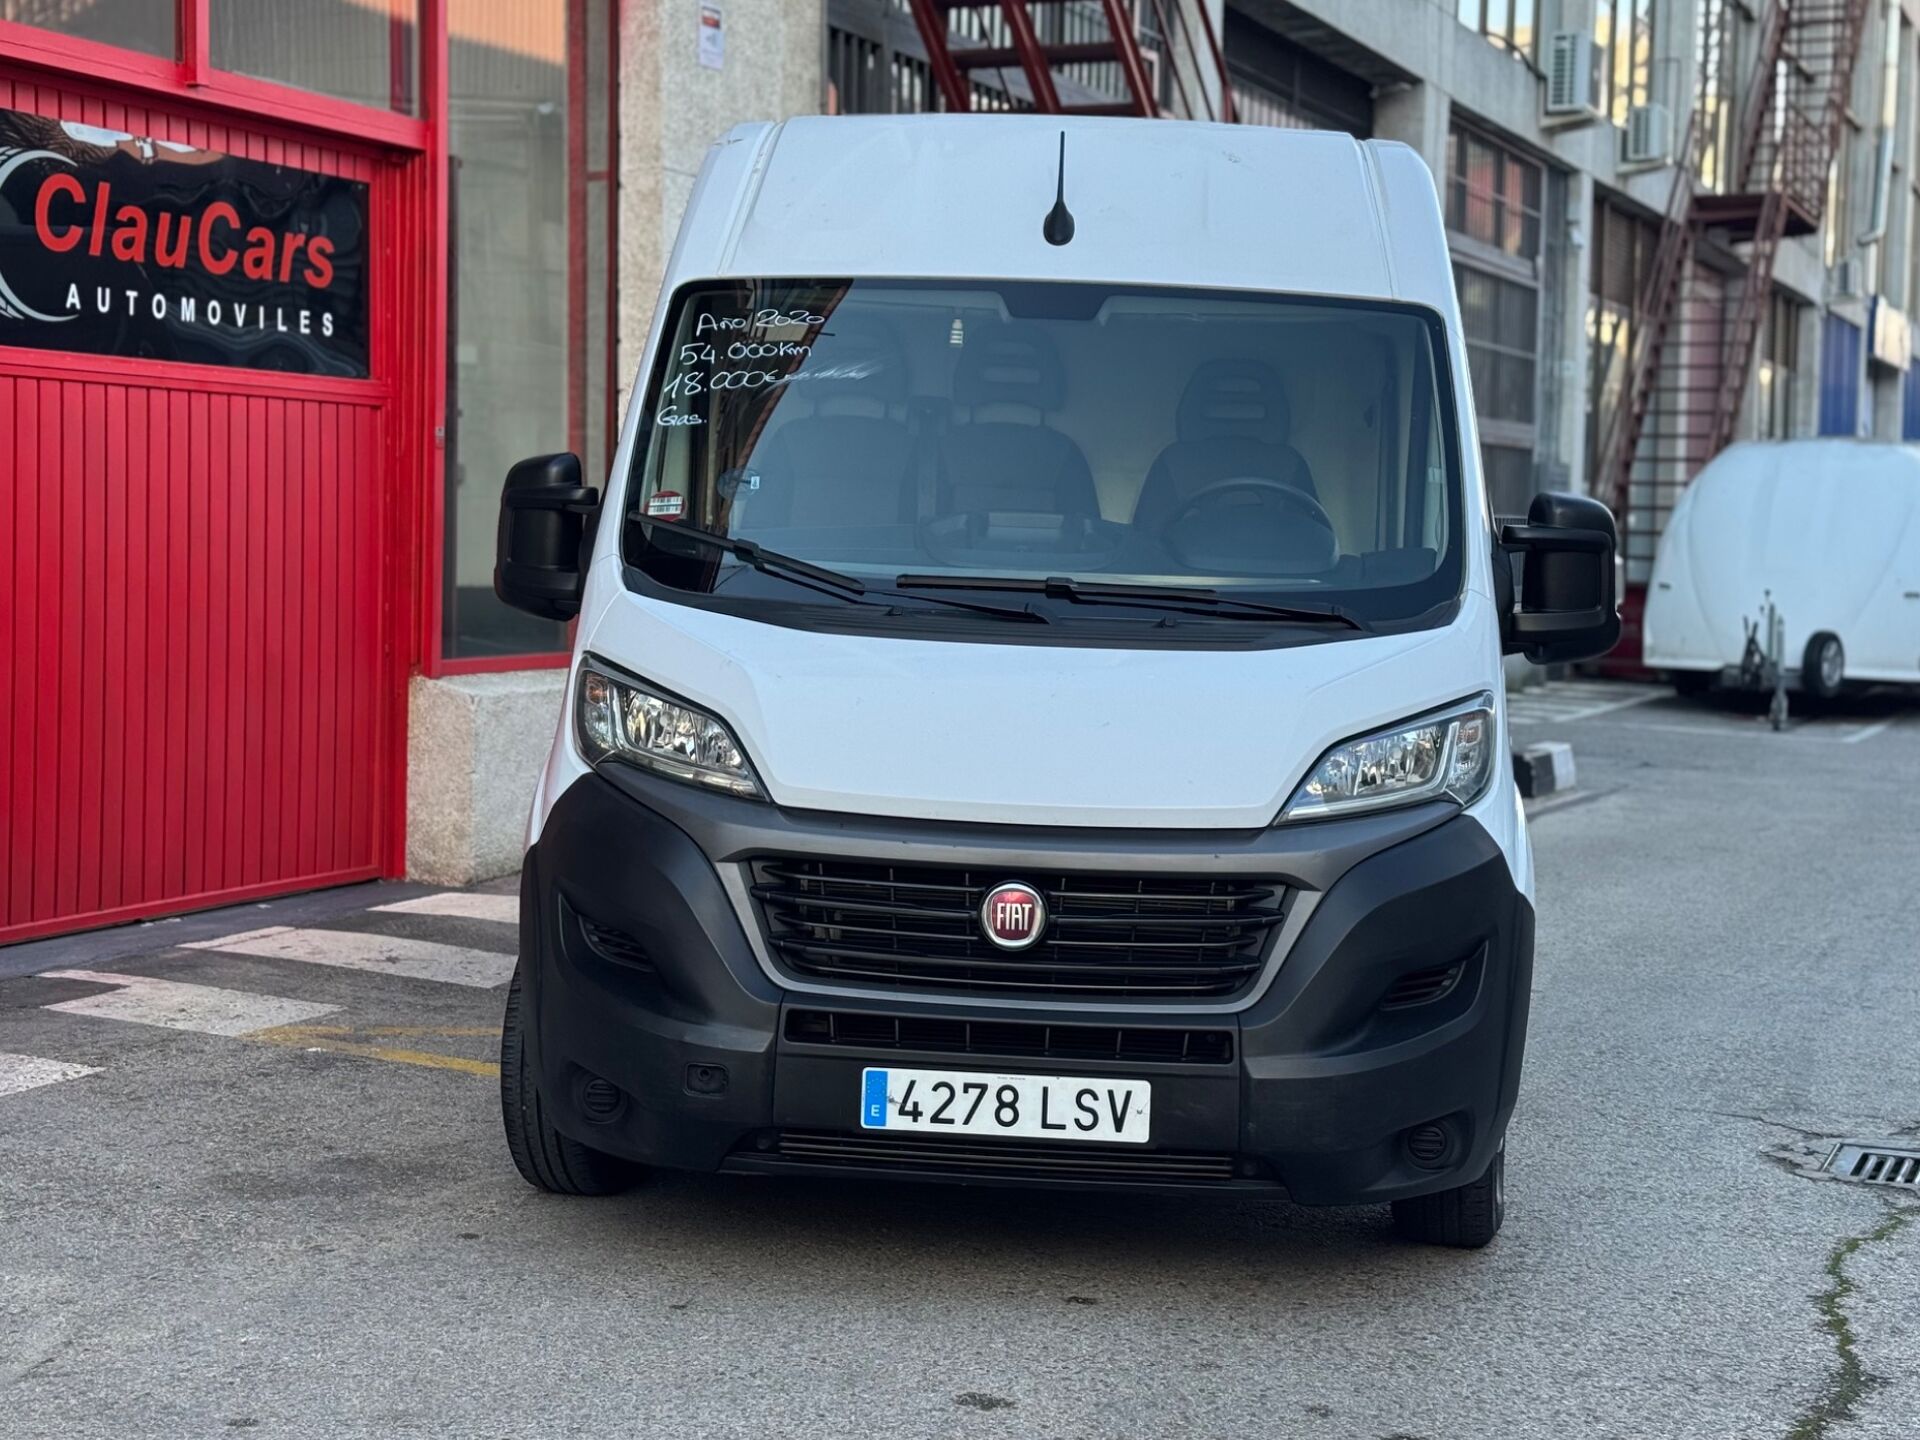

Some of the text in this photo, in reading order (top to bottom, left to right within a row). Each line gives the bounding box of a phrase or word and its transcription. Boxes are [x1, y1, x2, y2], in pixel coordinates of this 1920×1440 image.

[35, 172, 335, 289] ClauCars
[65, 283, 335, 337] AUTOMOVILES
[695, 308, 825, 337] Año 2020
[996, 902, 1032, 931] FIAT
[870, 1079, 1133, 1134] E 4278 LSV
